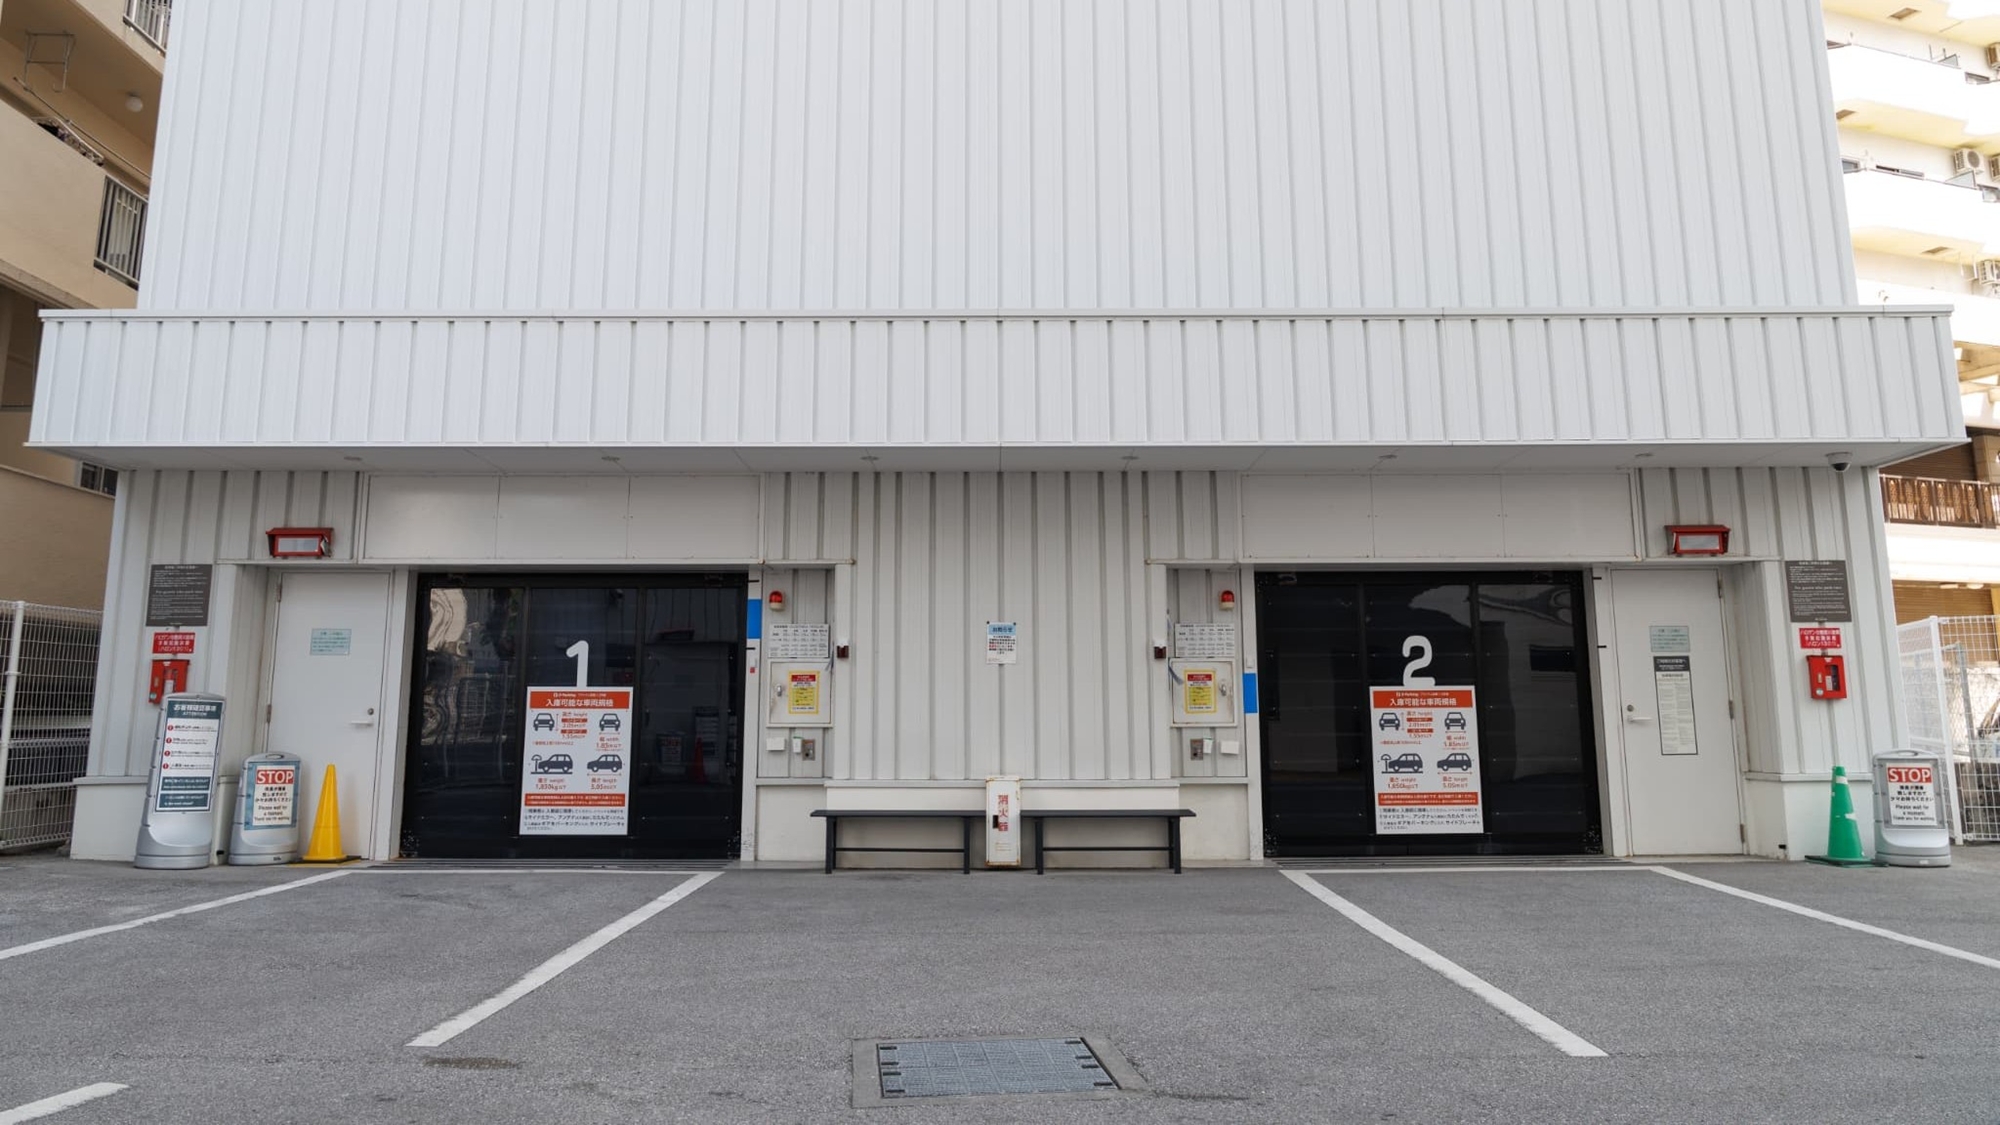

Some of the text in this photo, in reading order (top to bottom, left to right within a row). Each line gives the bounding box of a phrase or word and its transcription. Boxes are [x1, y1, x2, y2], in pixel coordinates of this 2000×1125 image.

[566, 640, 589, 687] 1
[1402, 635, 1435, 687] 2
[257, 770, 294, 784] STOP
[1889, 768, 1931, 782] STOP
